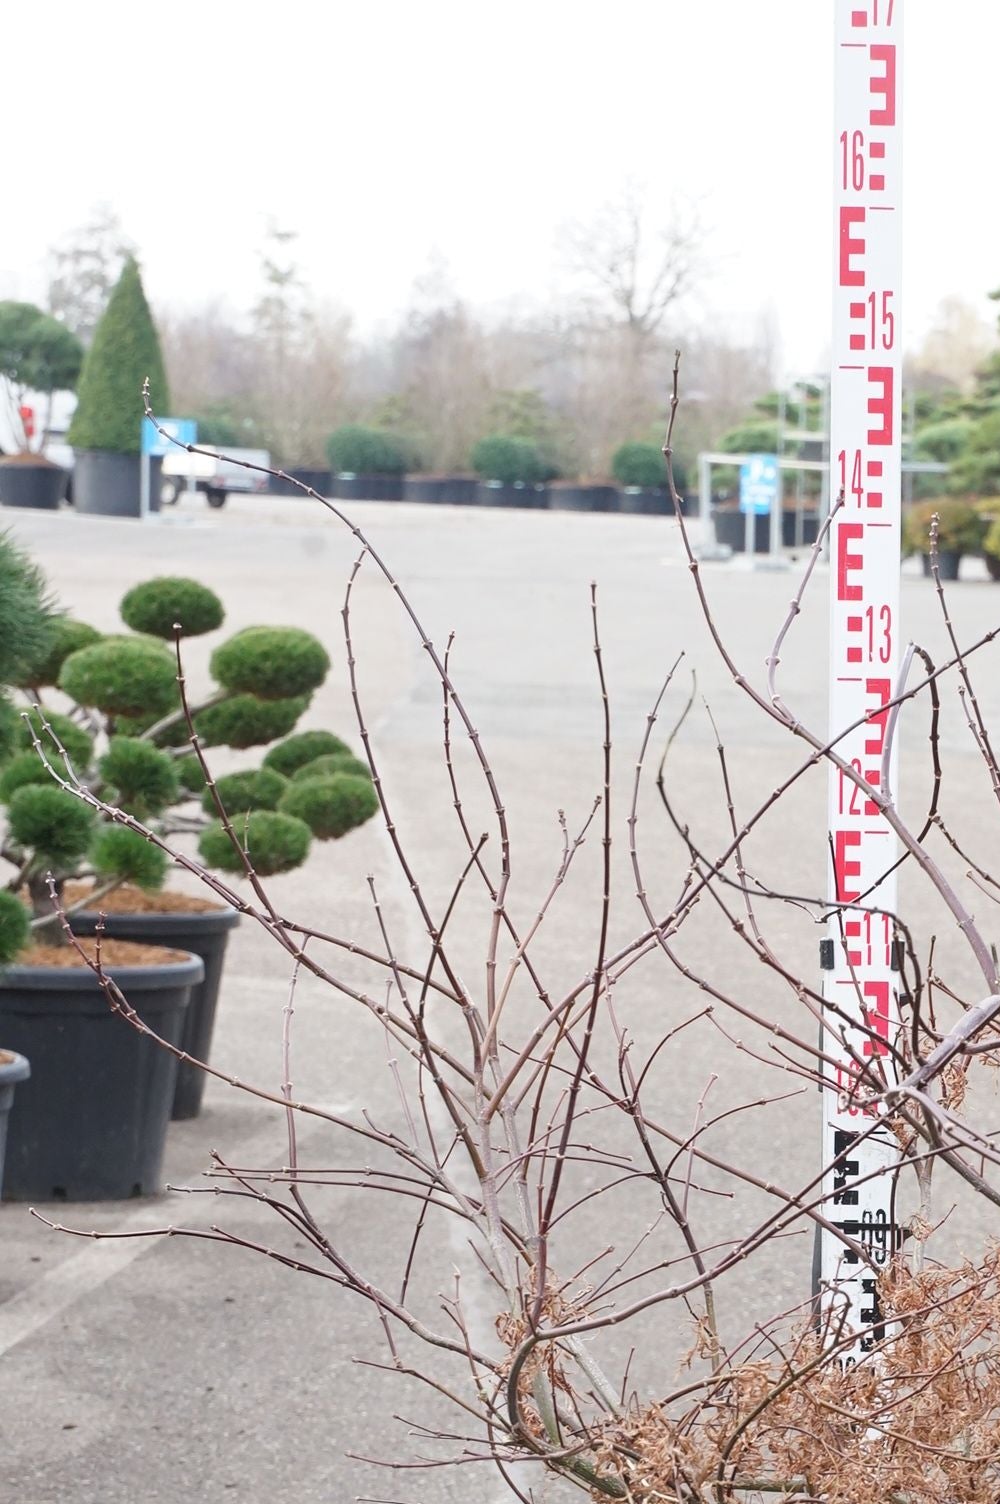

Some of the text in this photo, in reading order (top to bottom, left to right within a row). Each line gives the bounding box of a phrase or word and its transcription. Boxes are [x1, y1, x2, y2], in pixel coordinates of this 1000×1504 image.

[840, 130, 864, 191] 16
[868, 291, 893, 350] 15
[838, 449, 863, 508] 14
[866, 605, 891, 663] 13
[837, 758, 861, 815] 12
[864, 911, 889, 966] 11
